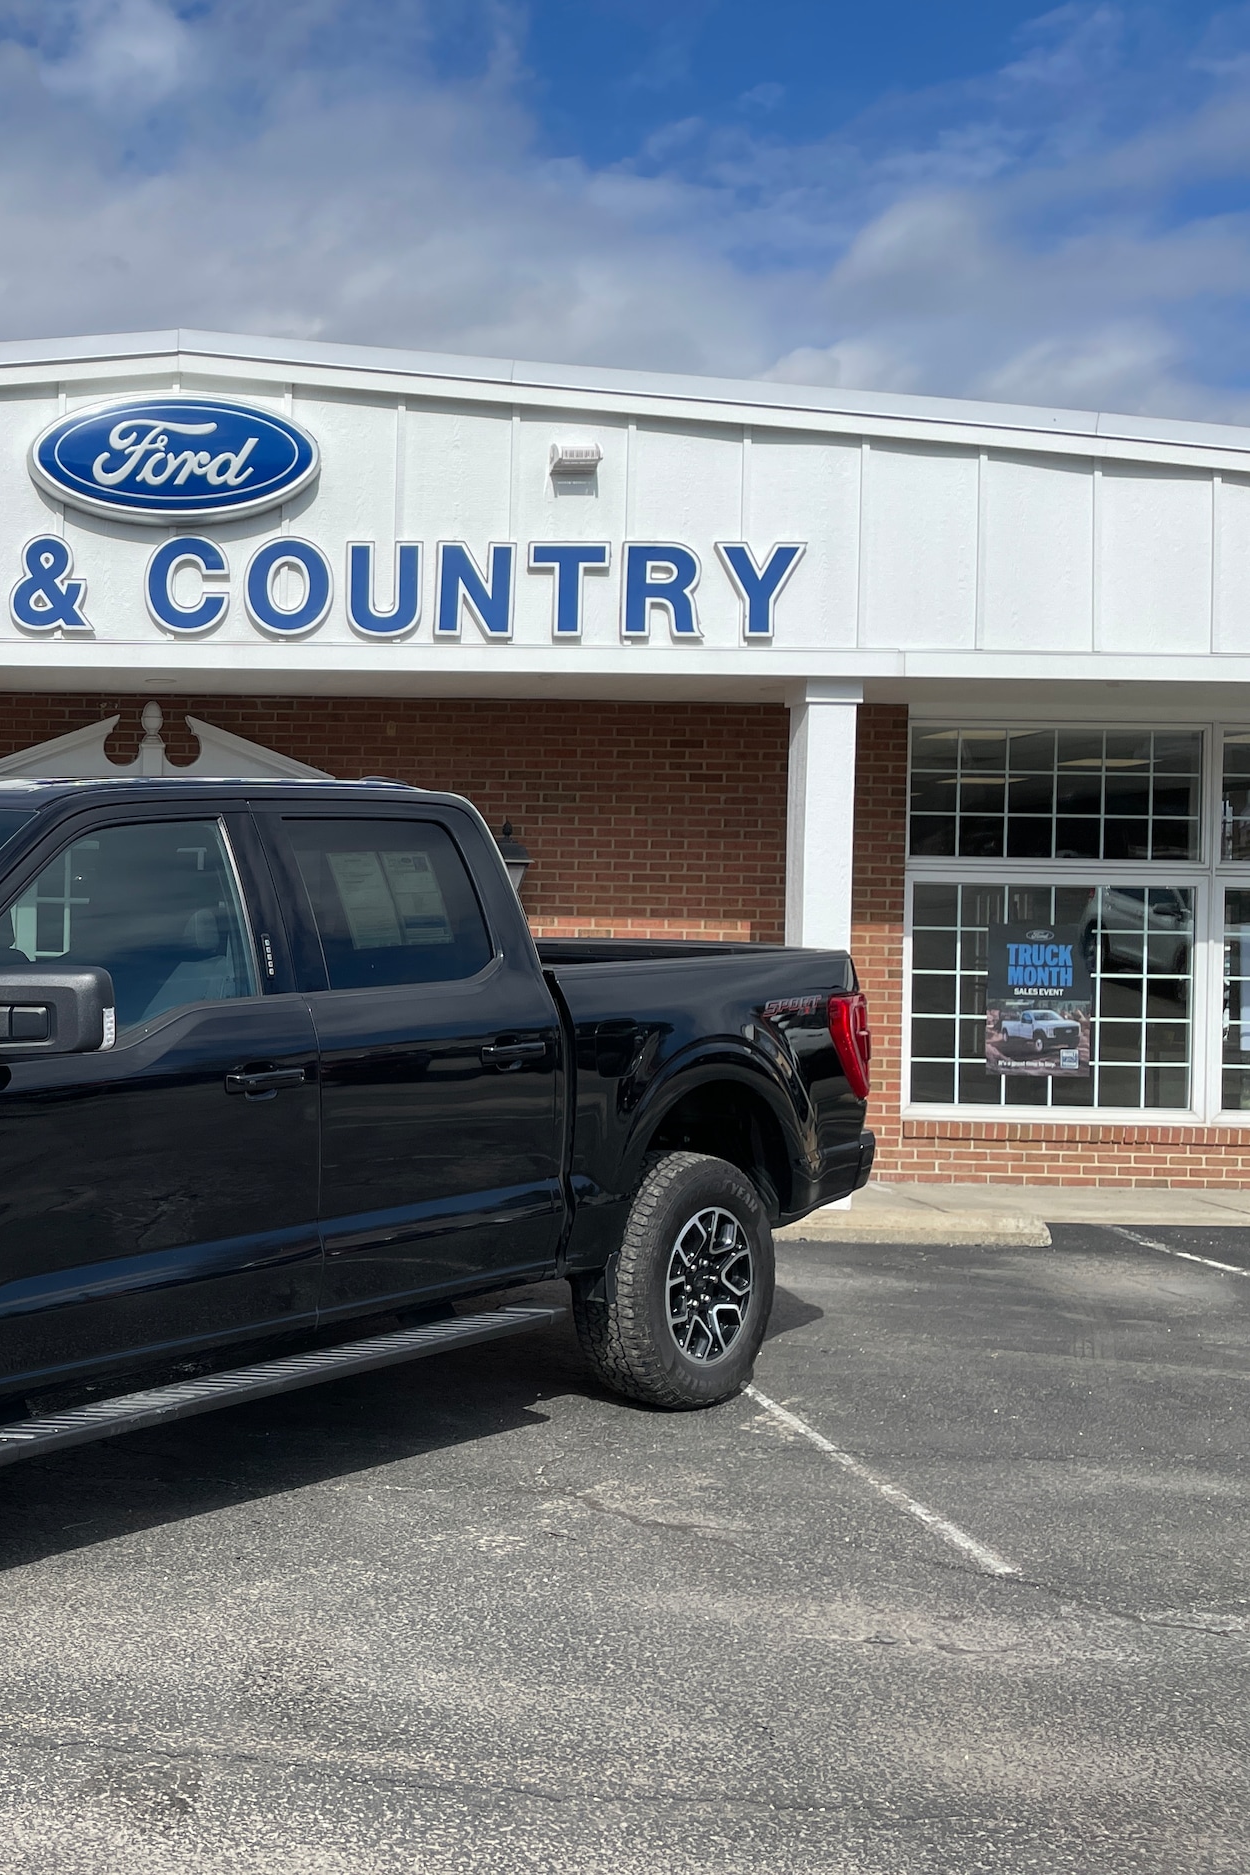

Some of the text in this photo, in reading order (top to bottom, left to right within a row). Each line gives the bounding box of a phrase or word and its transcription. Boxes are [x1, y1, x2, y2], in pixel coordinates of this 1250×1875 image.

[92, 419, 259, 486] Ford
[8, 533, 94, 631] &
[144, 534, 806, 638] COUNTRY
[1006, 943, 1073, 966] TRUCK
[1007, 966, 1073, 987] MONTH
[1014, 988, 1064, 996] SALES EVENT
[763, 995, 822, 1017] SPORT
